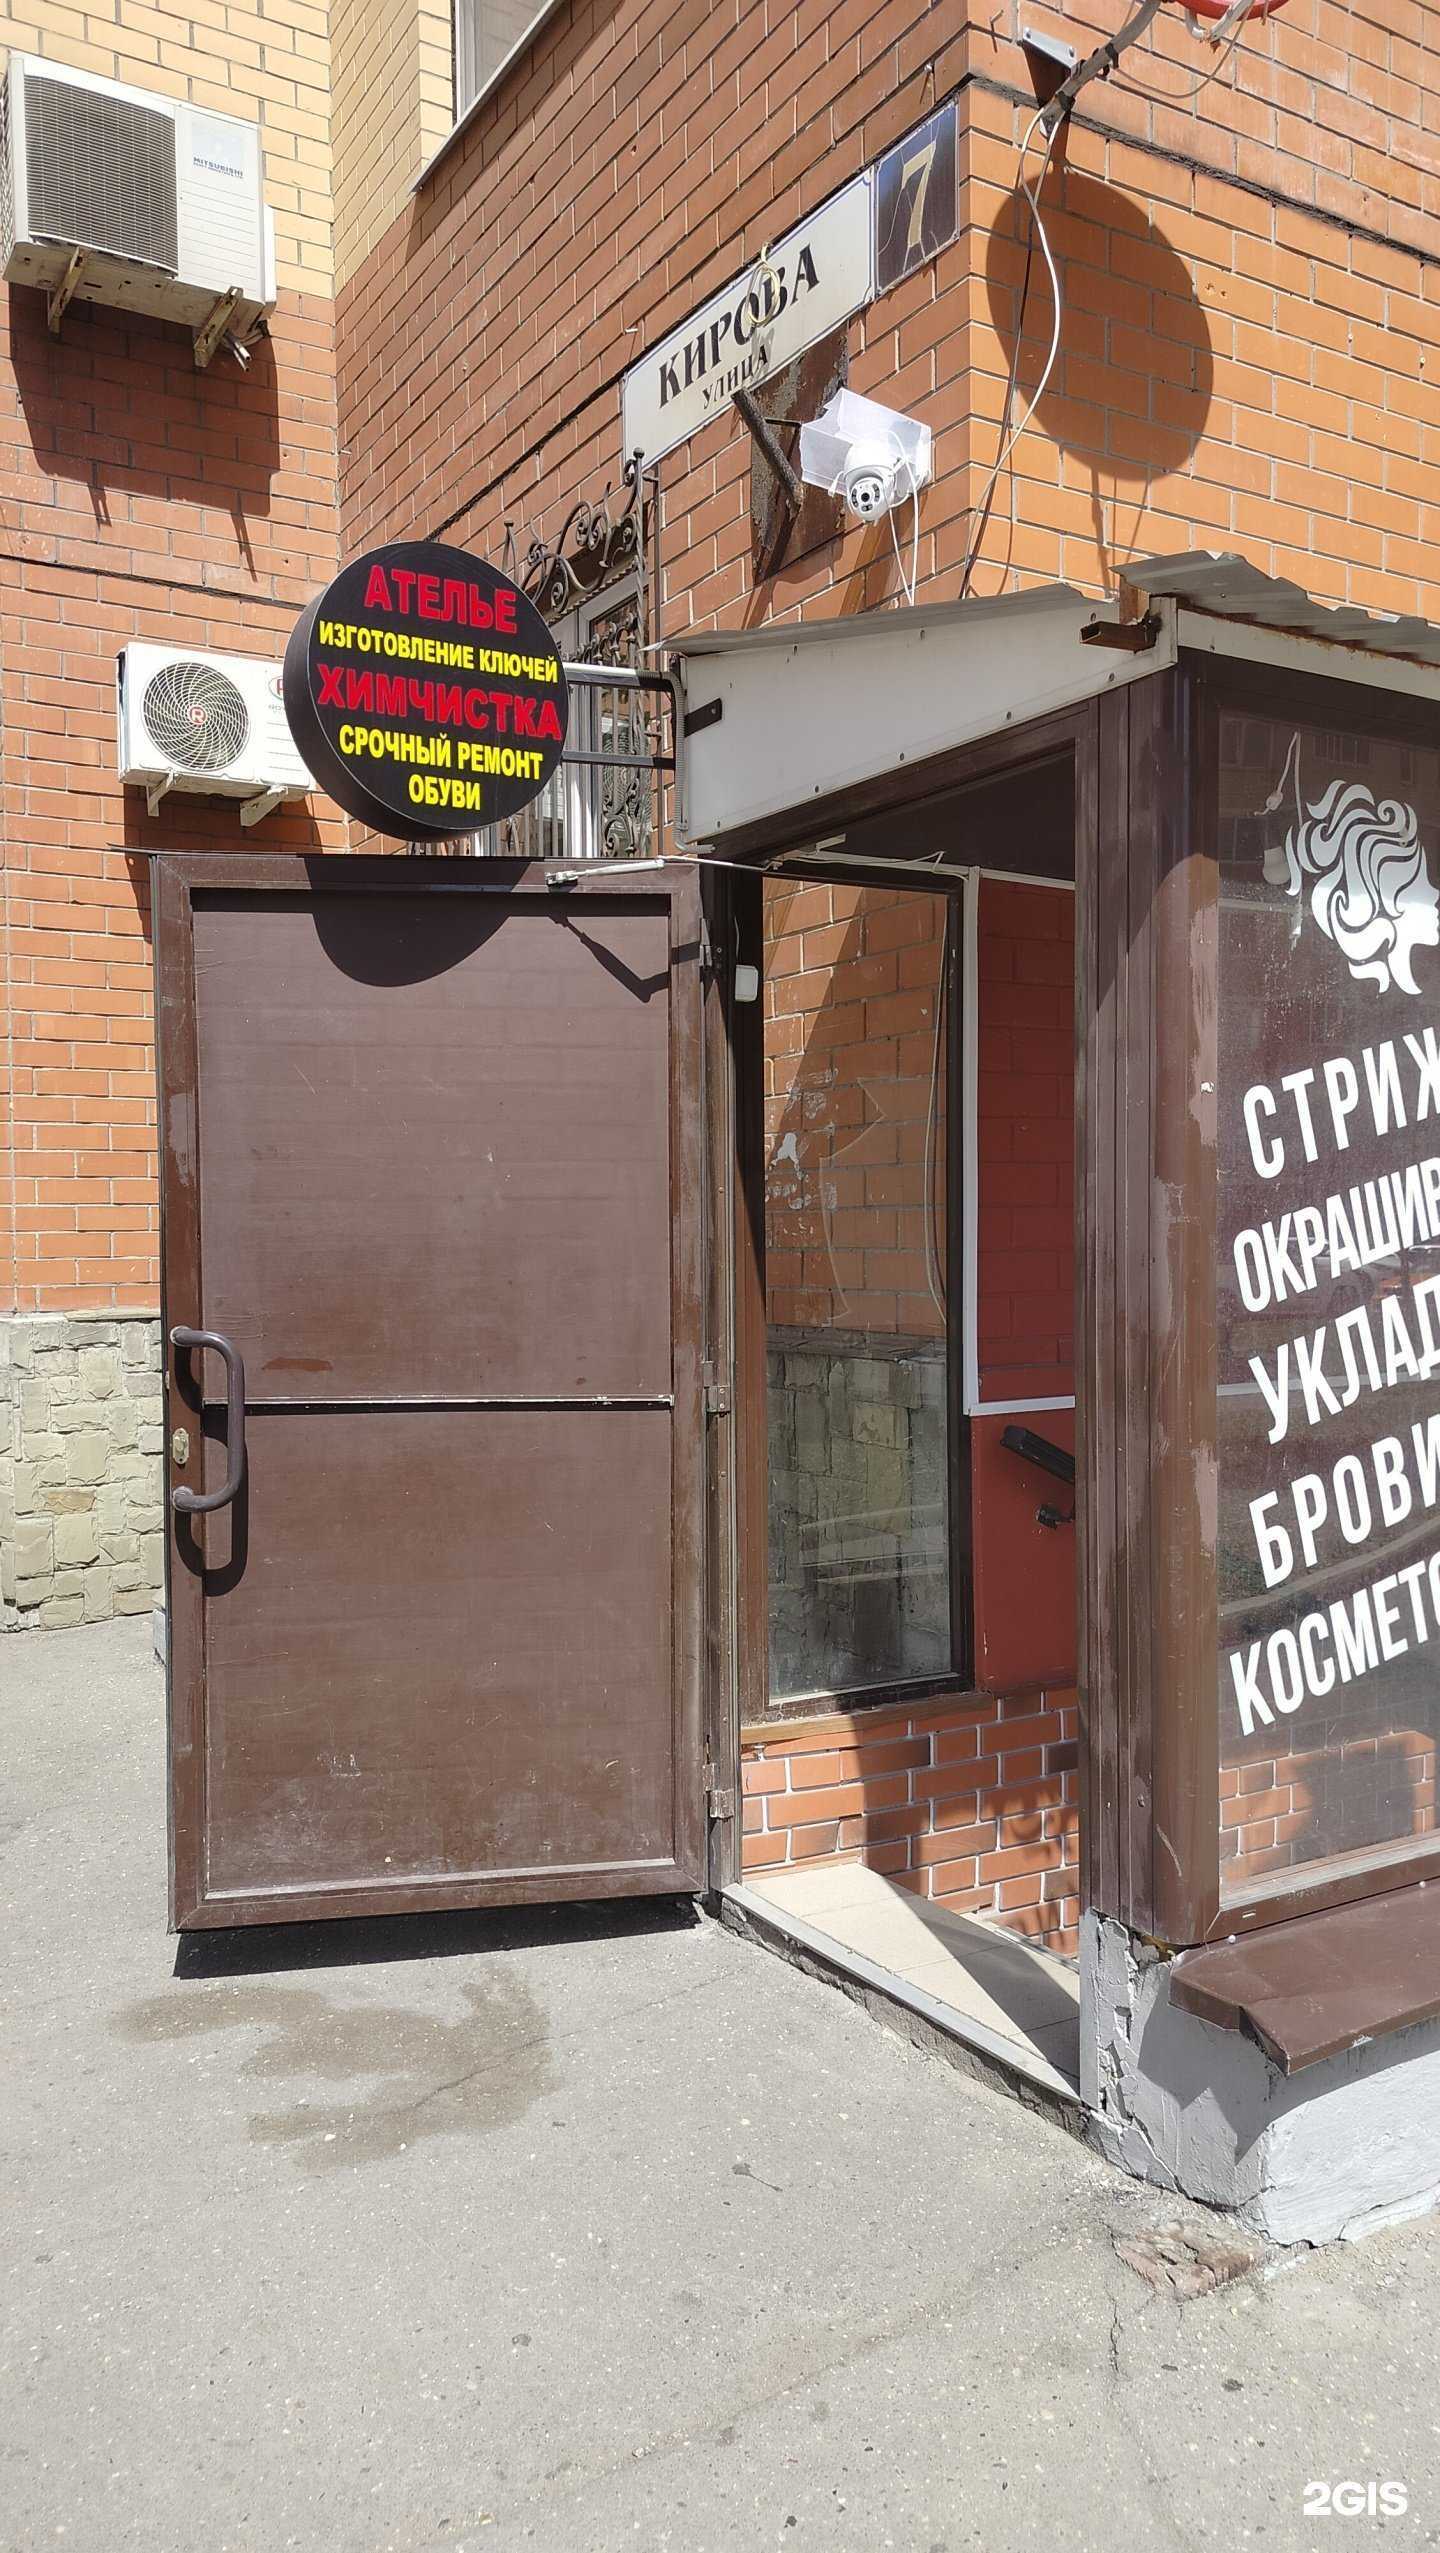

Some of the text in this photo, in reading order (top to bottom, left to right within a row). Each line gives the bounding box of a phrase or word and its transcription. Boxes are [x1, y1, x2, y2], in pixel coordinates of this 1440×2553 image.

[901, 139, 937, 248] 7
[658, 242, 820, 408] КИРОВА
[702, 344, 768, 410] УЛИЦА
[364, 564, 517, 634] АТЕЛЬЕ
[319, 620, 558, 683] ИЗГОТОВЛЕНИЕ КЛЮЧЕЙ
[317, 663, 562, 741] ХИМЧИСТКА
[339, 724, 543, 780] СРОЧНЫЙ РЕМОНТ
[408, 773, 480, 810] ОБУВИ
[1243, 1027, 1440, 1179] СТРИЖ
[1248, 1274, 1440, 1444] УКЛАД
[1248, 1413, 1440, 1589] БРОВИ
